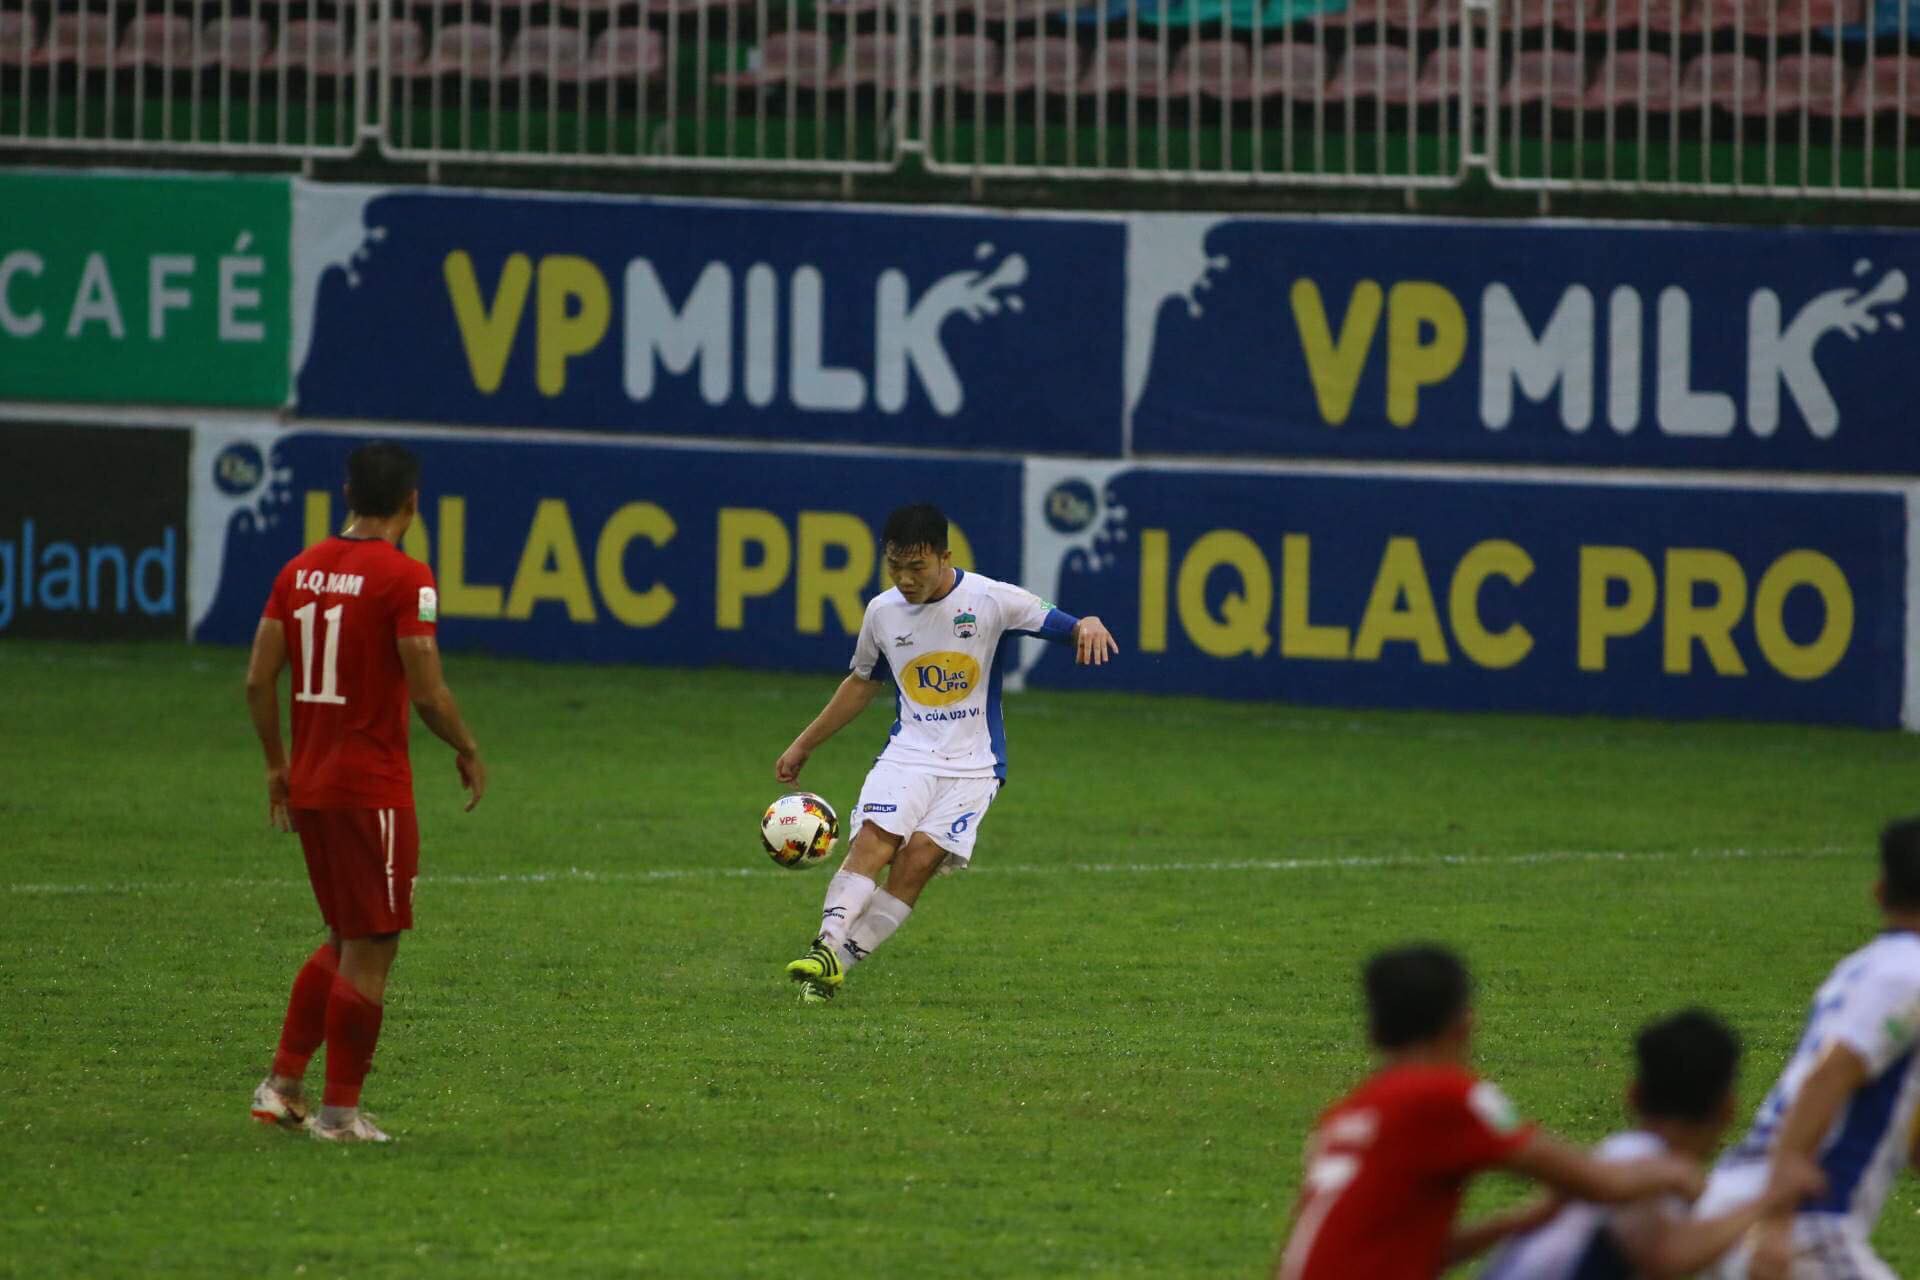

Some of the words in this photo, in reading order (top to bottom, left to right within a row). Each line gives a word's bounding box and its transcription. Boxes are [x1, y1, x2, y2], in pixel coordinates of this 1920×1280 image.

[0, 231, 265, 341] CAFÉ
[443, 249, 1028, 416] VPMILK
[1290, 268, 1908, 438] VPMILK
[715, 507, 975, 636] PR
[1138, 528, 1536, 669] IQLAC
[1578, 546, 1855, 681] PRO
[293, 601, 346, 705] 11
[946, 682, 968, 691] Pro
[779, 816, 798, 825] VPF
[951, 812, 976, 833] 6
